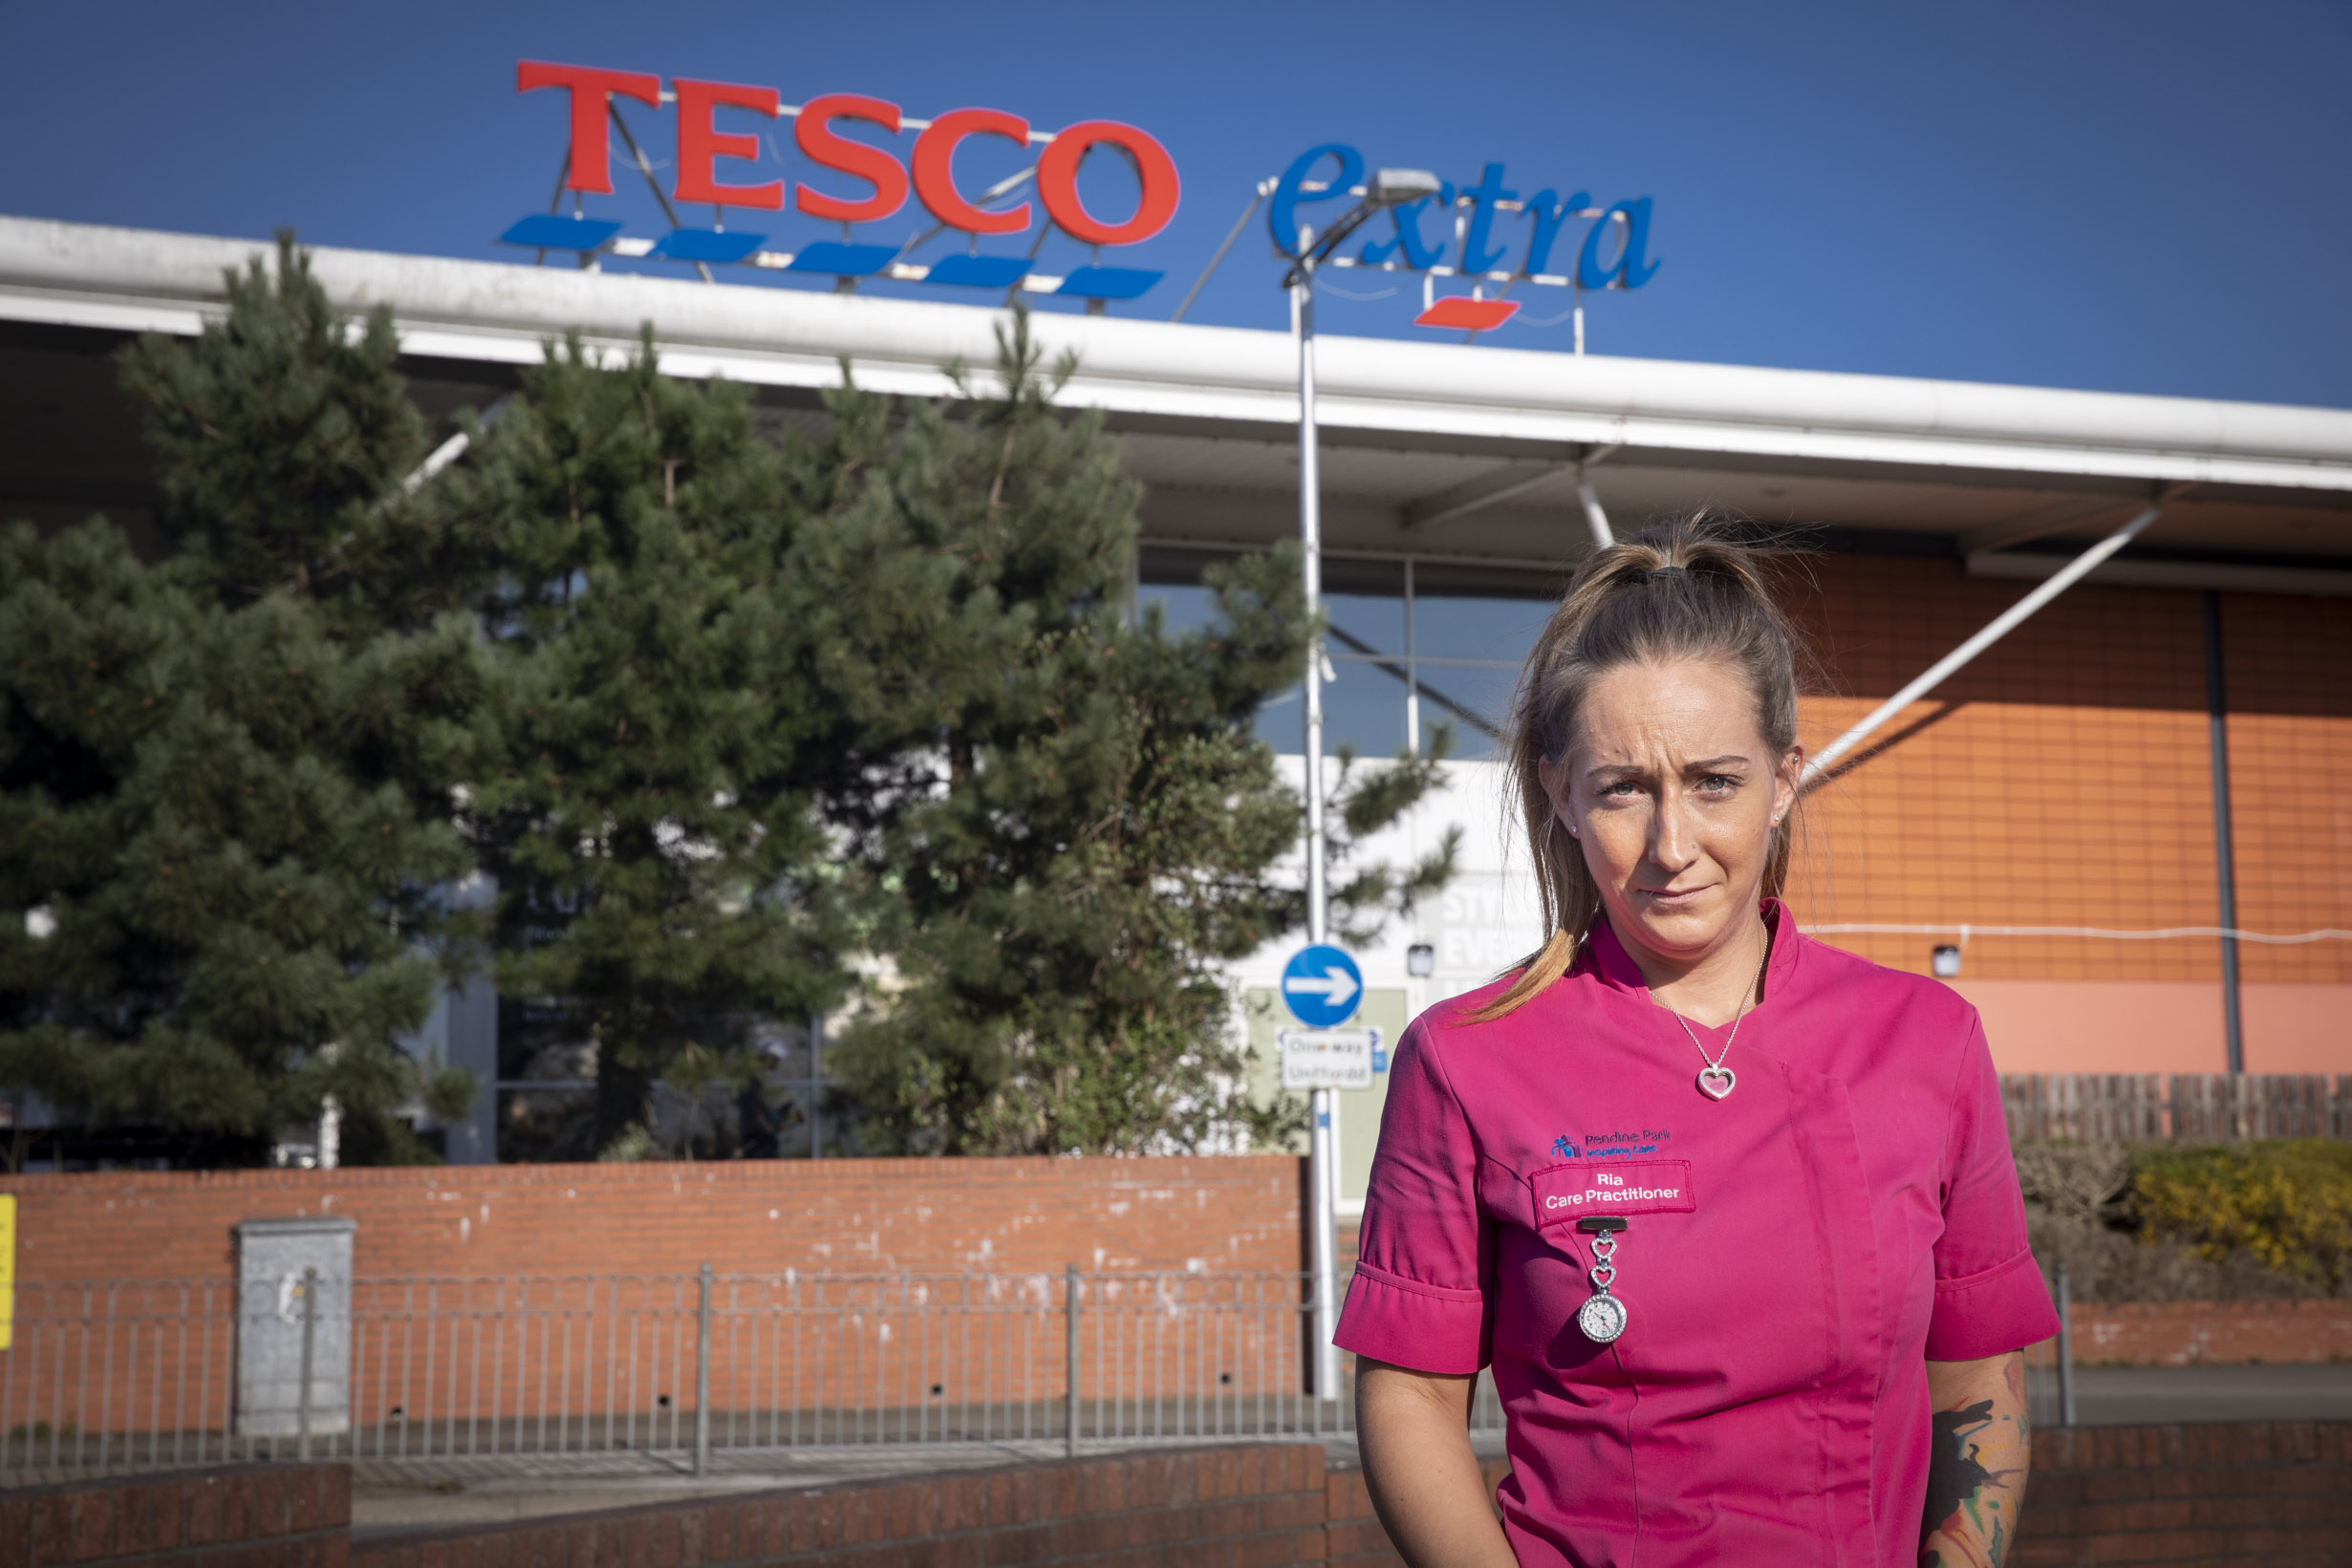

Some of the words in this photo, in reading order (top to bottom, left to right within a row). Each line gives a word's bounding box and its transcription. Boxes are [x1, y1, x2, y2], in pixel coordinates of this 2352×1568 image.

[517, 59, 1181, 247] TESCO
[1269, 142, 1663, 290] extra
[1586, 1131, 1639, 1146] Pendine
[1643, 1128, 1672, 1143] Park
[1597, 1172, 1624, 1187] Ria
[1545, 1194, 1584, 1210] Care
[1586, 1187, 1679, 1203] Practitioner
